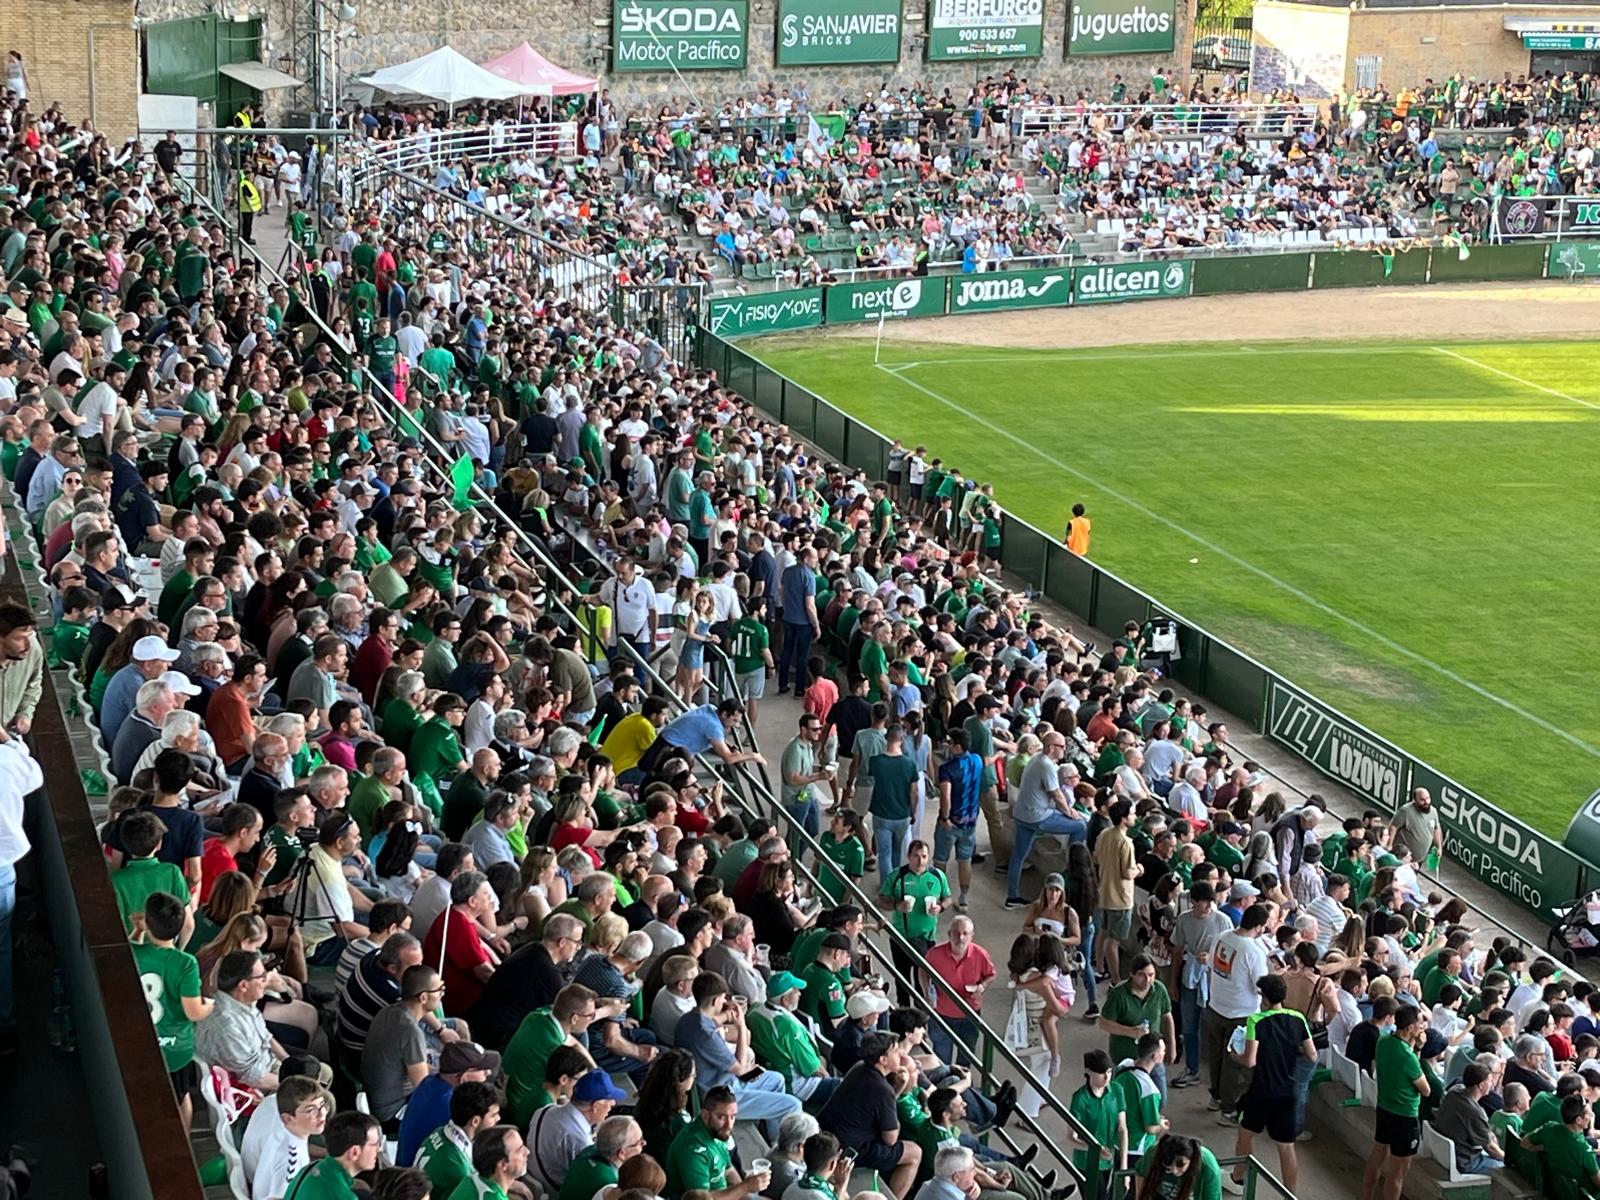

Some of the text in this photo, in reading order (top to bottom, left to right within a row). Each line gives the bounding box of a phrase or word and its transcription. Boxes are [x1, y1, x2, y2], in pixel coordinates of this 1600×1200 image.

[935, 0, 1042, 17] IBERFURGO
[802, 14, 897, 35] SANJAVIER
[1071, 5, 1170, 41] juguettos
[802, 36, 852, 46] BRICKS
[959, 28, 1017, 41] 900 533 657
[619, 40, 740, 61] Motor Pacífico
[1080, 267, 1160, 293] alicen
[737, 633, 751, 658] 11
[1480, 853, 1541, 909] Pacífico
